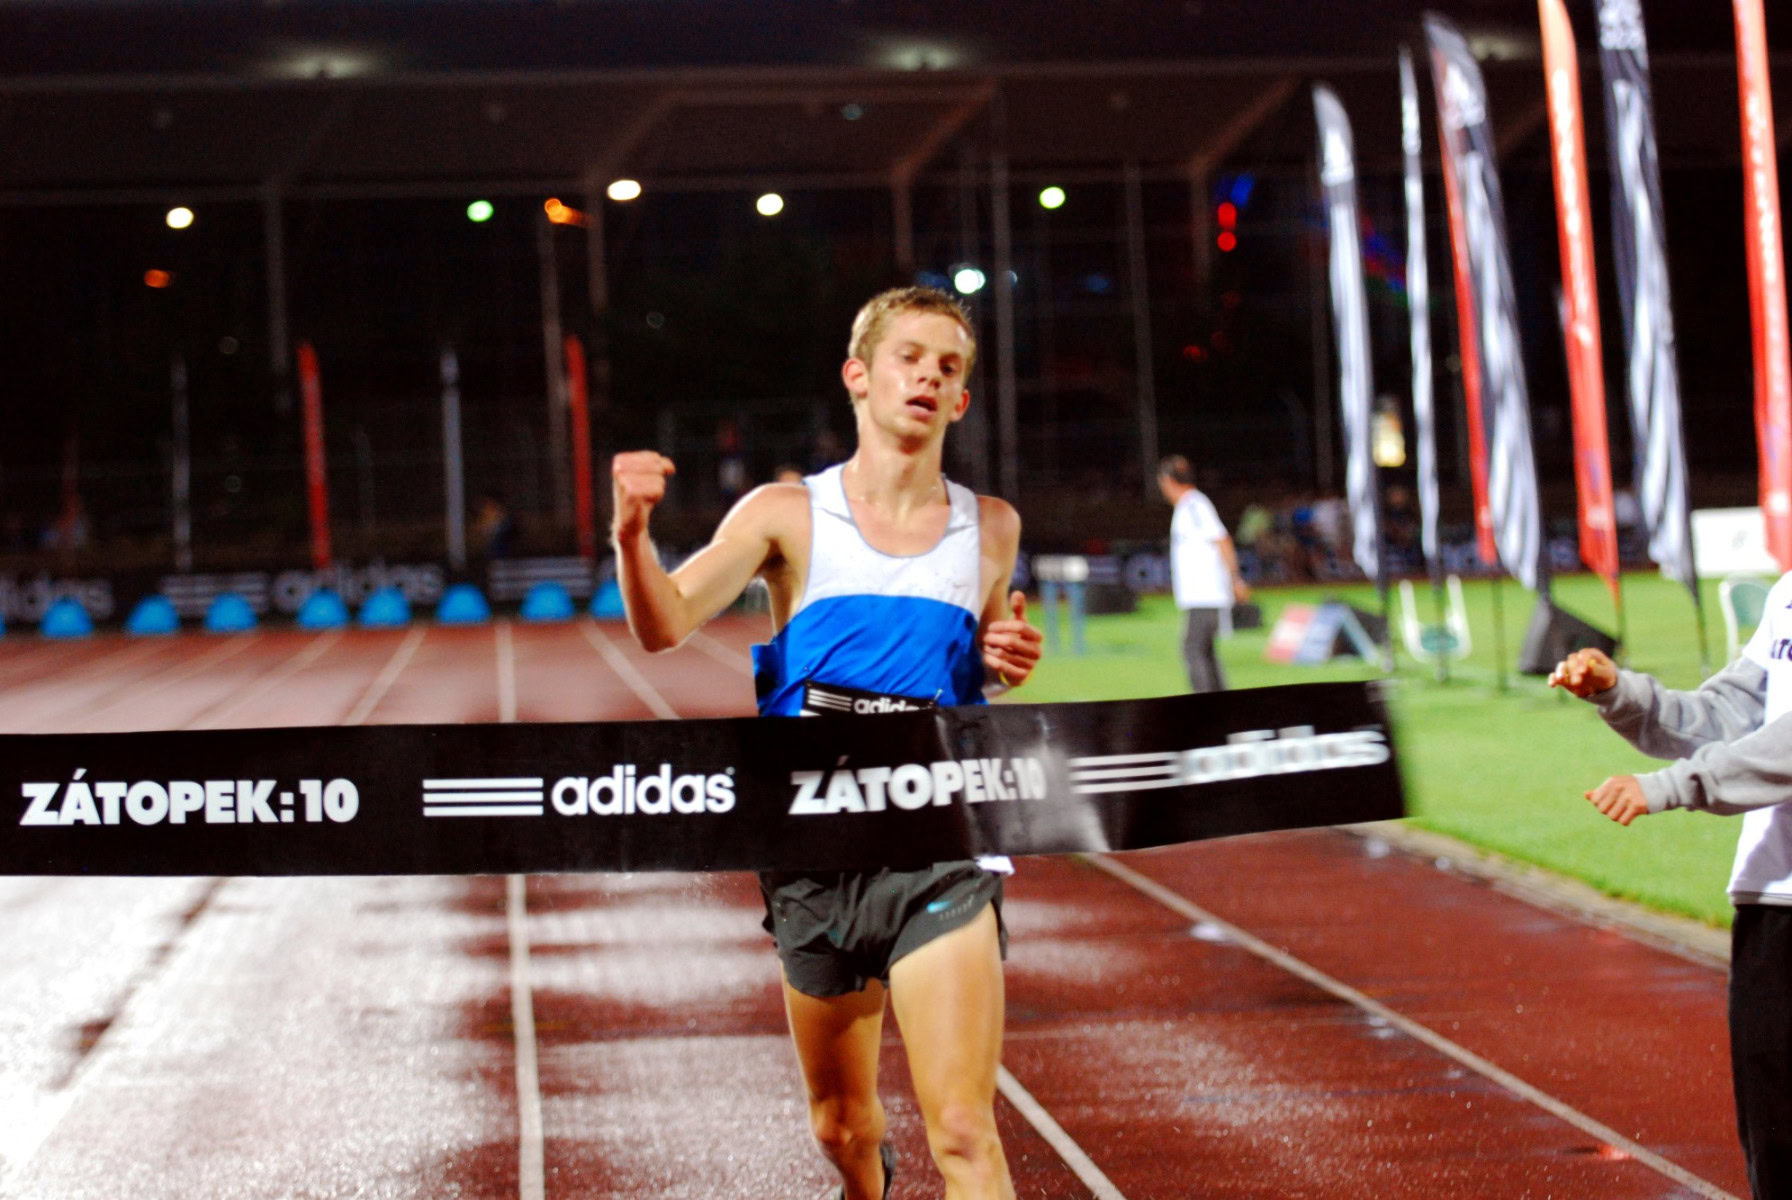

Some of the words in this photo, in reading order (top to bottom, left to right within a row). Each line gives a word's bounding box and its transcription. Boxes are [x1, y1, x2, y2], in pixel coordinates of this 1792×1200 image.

[20, 768, 359, 825] ZÁTOPEK:10
[552, 763, 736, 816] adidas
[788, 755, 1047, 815] ZÁTOPEK:10
